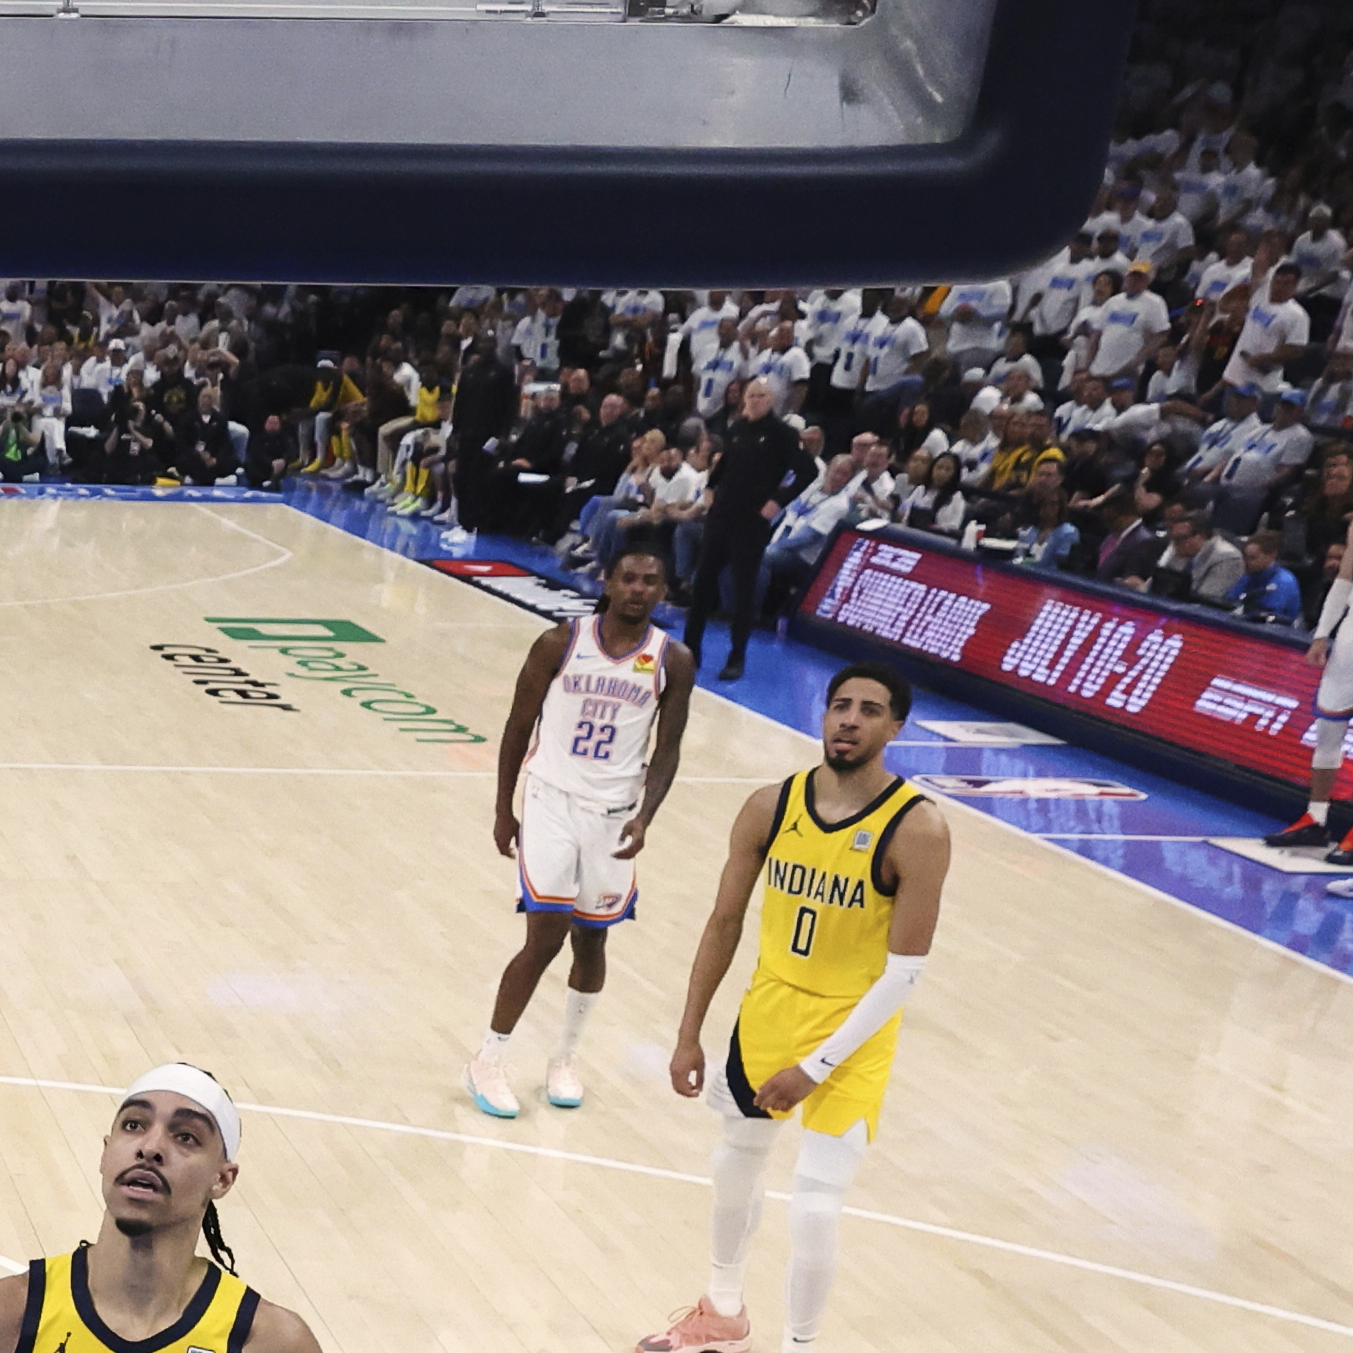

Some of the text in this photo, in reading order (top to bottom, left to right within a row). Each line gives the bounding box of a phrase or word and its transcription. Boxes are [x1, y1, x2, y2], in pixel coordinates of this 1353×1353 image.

[149, 643, 302, 713] center
[1001, 599, 1184, 714] JULY 10-20
[246, 644, 488, 744] paycom
[562, 674, 653, 709] OKLAHOMA
[580, 697, 623, 722] CITY
[569, 720, 617, 761] 22
[764, 856, 867, 910] INDIANA
[788, 904, 819, 959] 0
